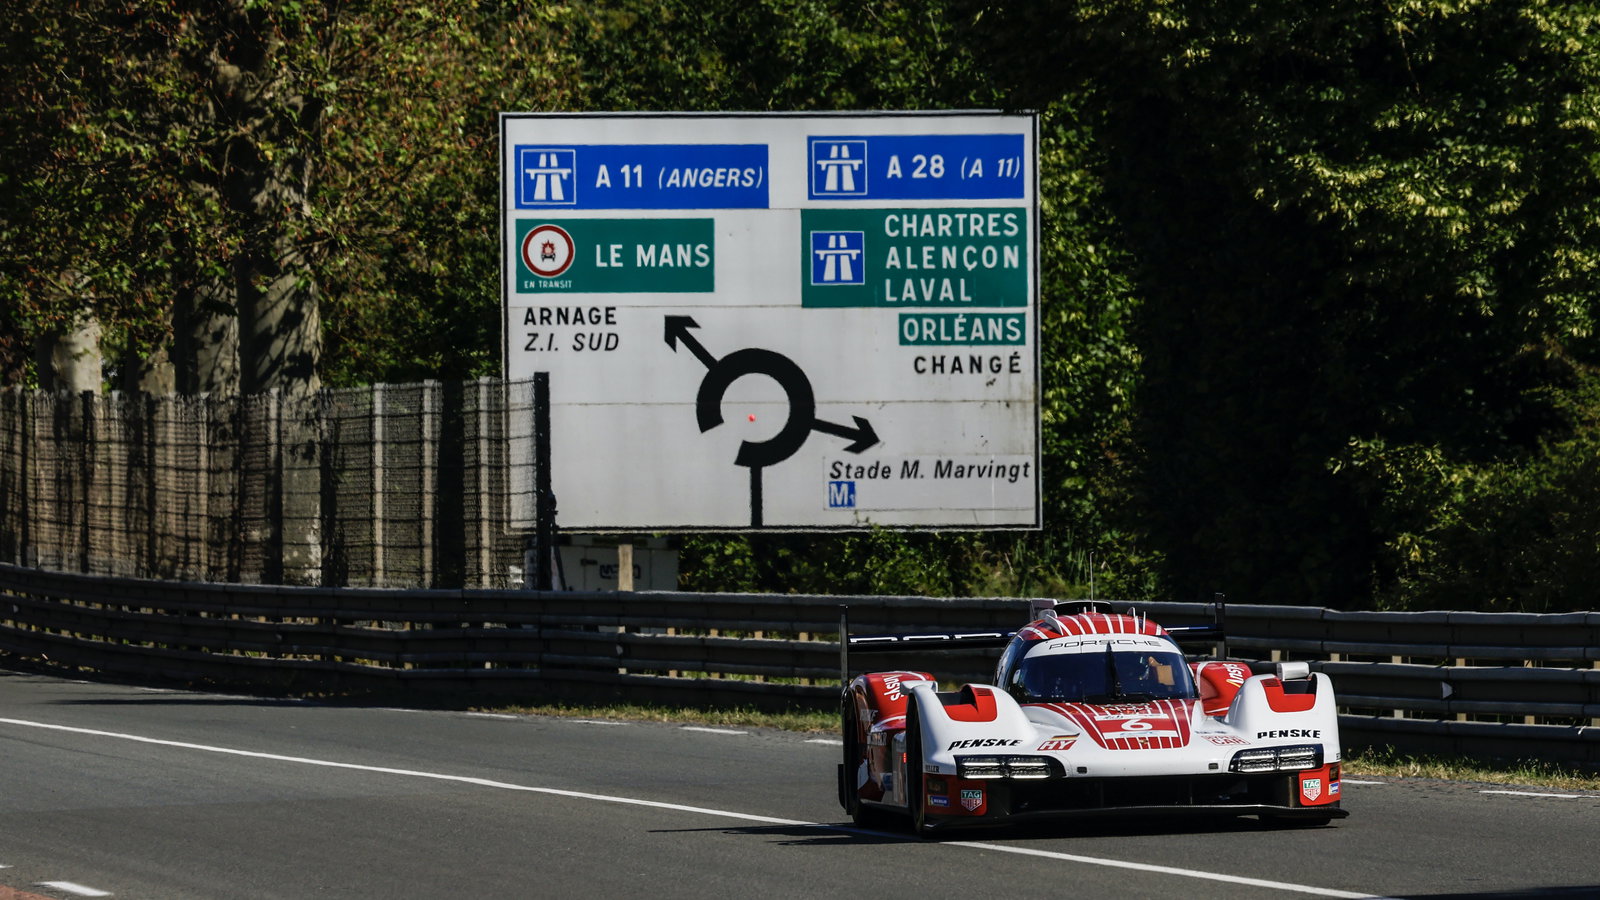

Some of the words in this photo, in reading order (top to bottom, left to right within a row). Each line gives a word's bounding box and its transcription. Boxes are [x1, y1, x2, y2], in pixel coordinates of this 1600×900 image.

[595, 164, 611, 188] A
[620, 164, 643, 188] 11
[658, 166, 763, 190] (ANGERS)
[887, 155, 903, 179] A
[912, 154, 945, 179] 28
[961, 157, 984, 180] (A
[997, 157, 1021, 179] 11)
[885, 213, 1019, 238] CHARTRES
[596, 244, 624, 267] LE
[636, 244, 710, 268] MANS
[885, 245, 1019, 271] ALENÇON
[524, 280, 535, 289] EN
[538, 280, 572, 289] TRANSIT
[885, 278, 972, 301] LAVAL
[524, 307, 617, 326] ARNAGE
[903, 314, 1021, 342] ORLÉANS
[524, 333, 559, 352] Z.I.
[572, 333, 620, 352] SUD
[914, 352, 1021, 374] CHANGÉ
[829, 461, 892, 480] Stade
[900, 460, 925, 480] M.
[934, 460, 1030, 484] Marvingt
[1049, 639, 1162, 650] PORSCHE
[1121, 718, 1153, 731] 6
[1257, 728, 1321, 740] PENSKE
[947, 738, 1024, 751] PENSKE
[1304, 780, 1320, 788] TAG
